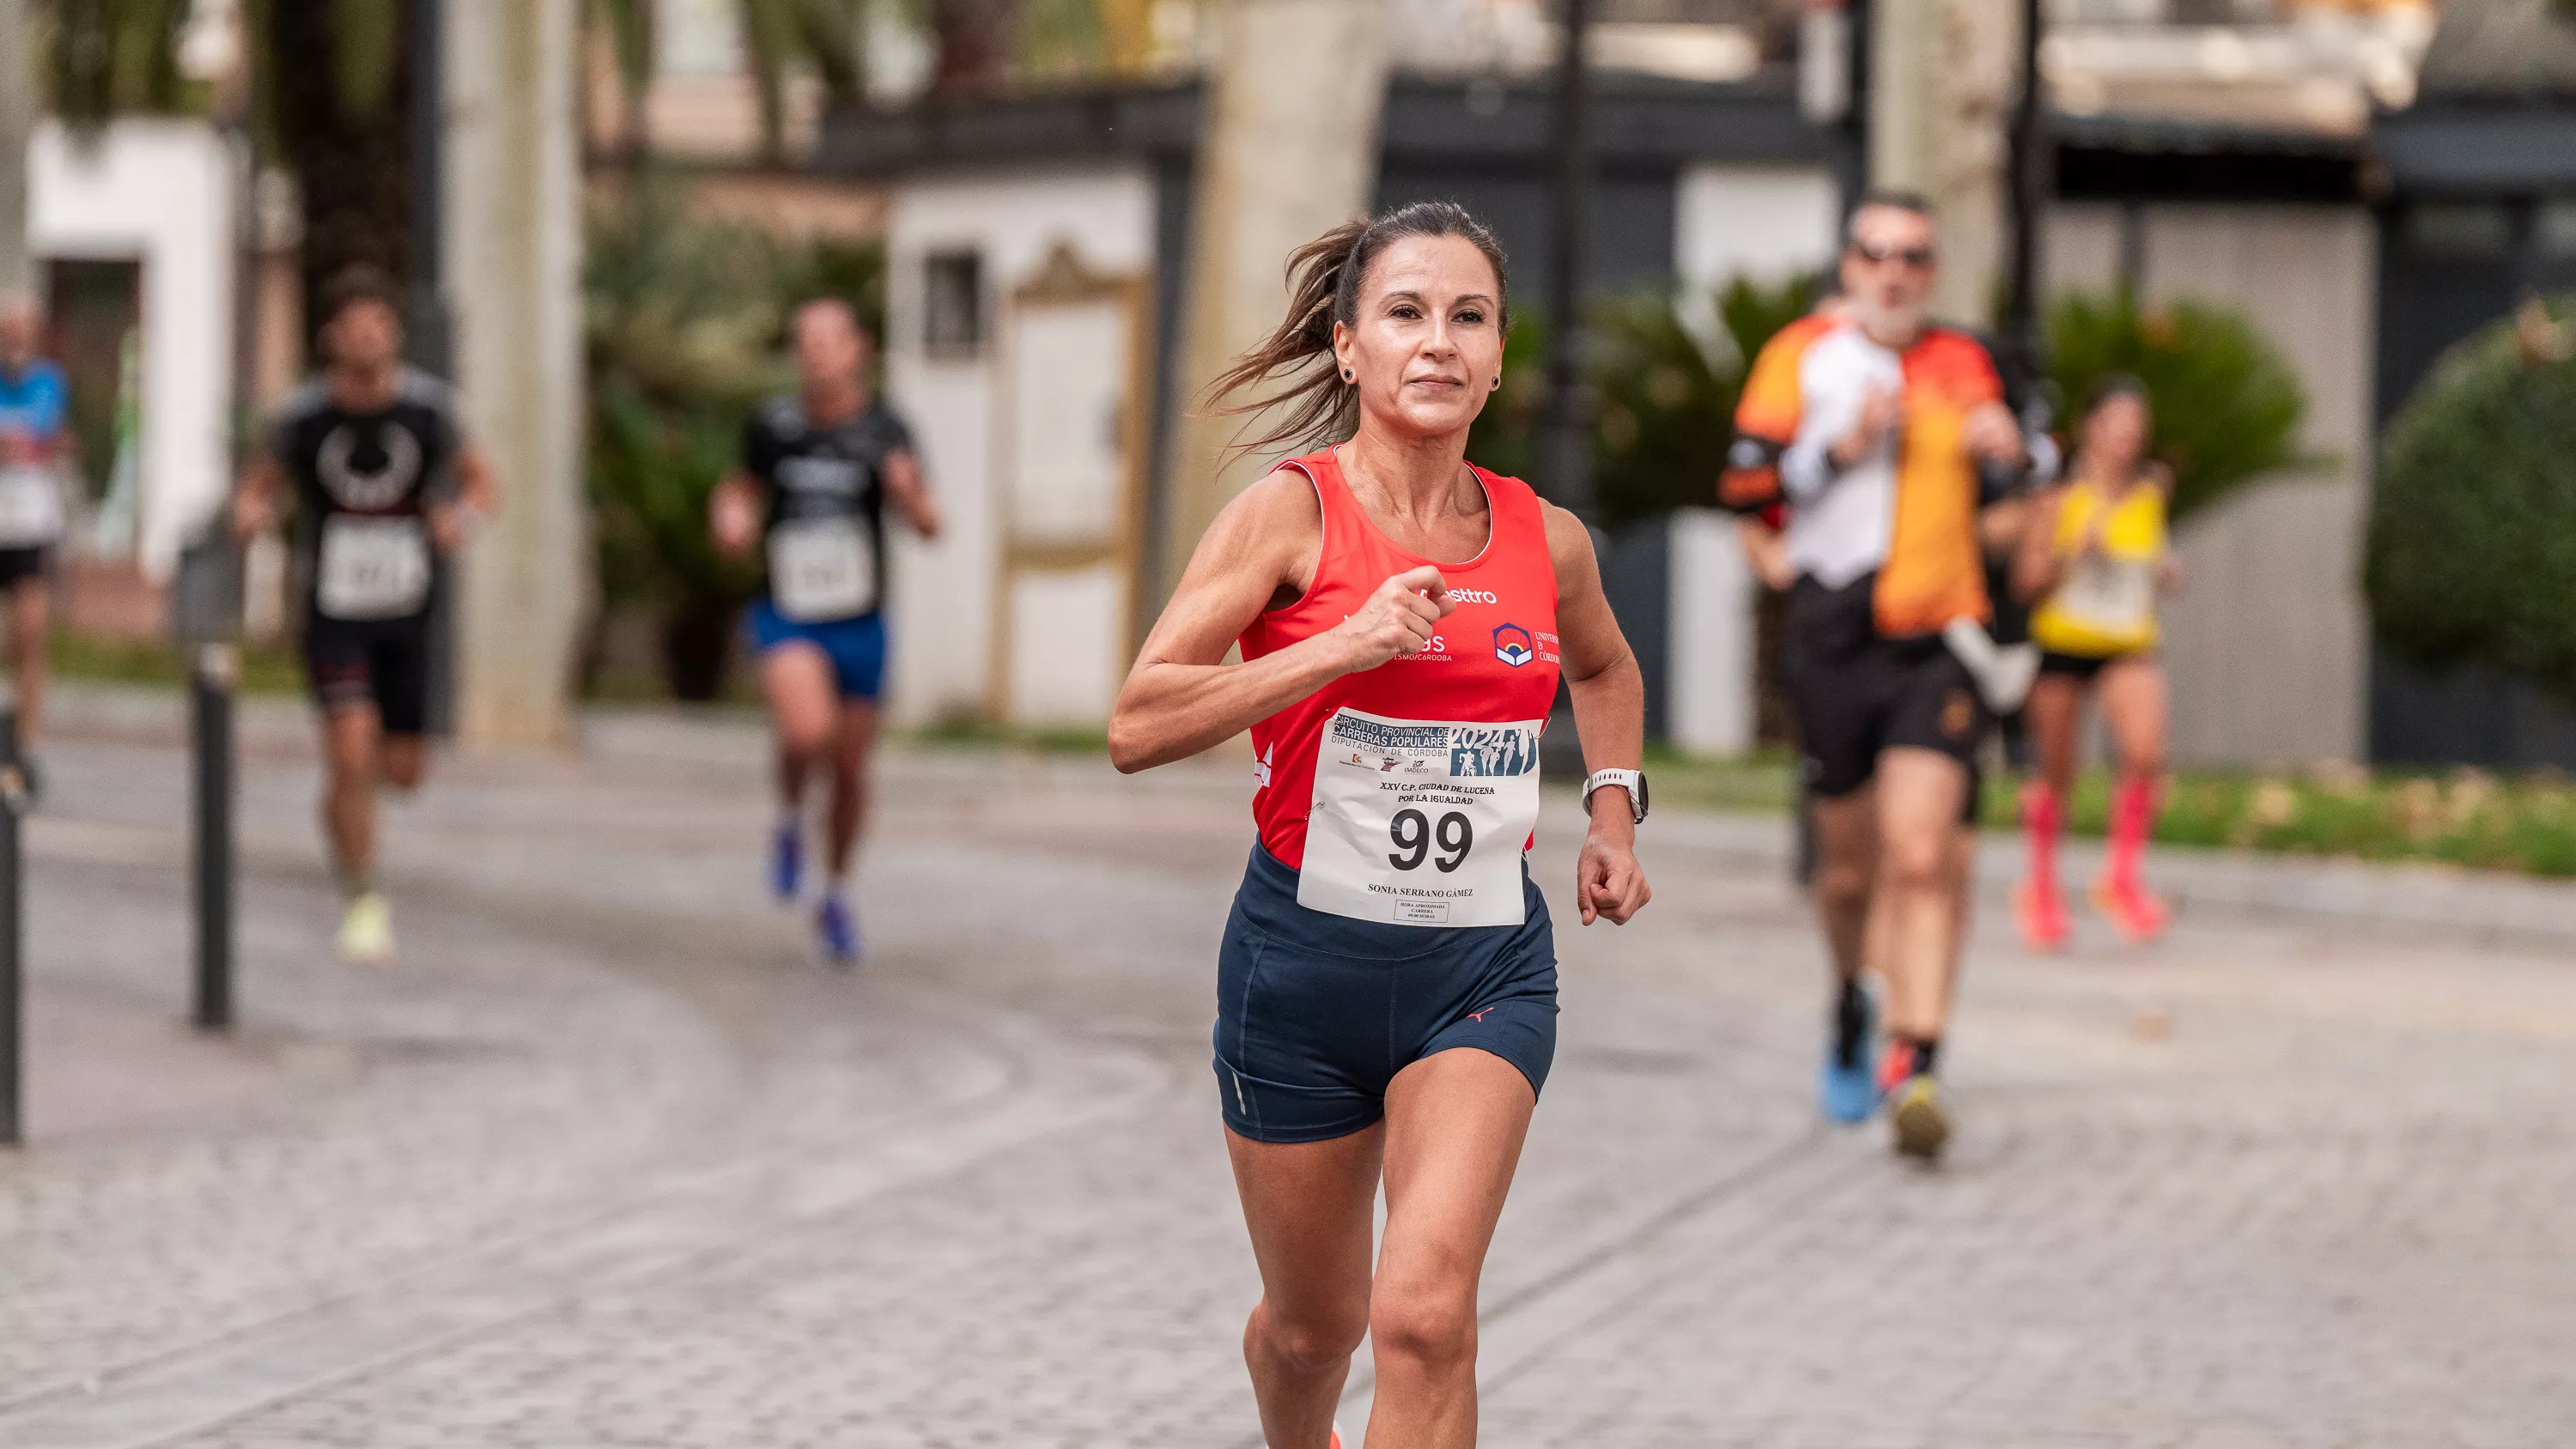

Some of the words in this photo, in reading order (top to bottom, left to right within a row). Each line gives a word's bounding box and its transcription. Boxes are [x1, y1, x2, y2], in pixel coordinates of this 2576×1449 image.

[1333, 724, 1388, 747] CARRERAS
[1390, 737, 1449, 748] POPULARES
[1335, 714, 1378, 734] CIRCUITO
[1381, 726, 1435, 737] PROVINCIAL
[1437, 727, 1449, 737] DE
[1331, 735, 1386, 754] DIPUTACIÓN
[1390, 748, 1402, 756] DE
[1407, 748, 1449, 757] CÓRDOBA
[1448, 727, 1505, 749] 2024
[1380, 782, 1401, 791] XXV
[1418, 783, 1449, 791] CIUDAD
[1463, 786, 1495, 795] LUCENA
[1430, 795, 1473, 805] IGUALDAD
[1388, 808, 1473, 874] 99
[1367, 883, 1398, 894] SONIA
[1400, 888, 1444, 898] SERRANO
[1445, 888, 1473, 898] GÁMEZ
